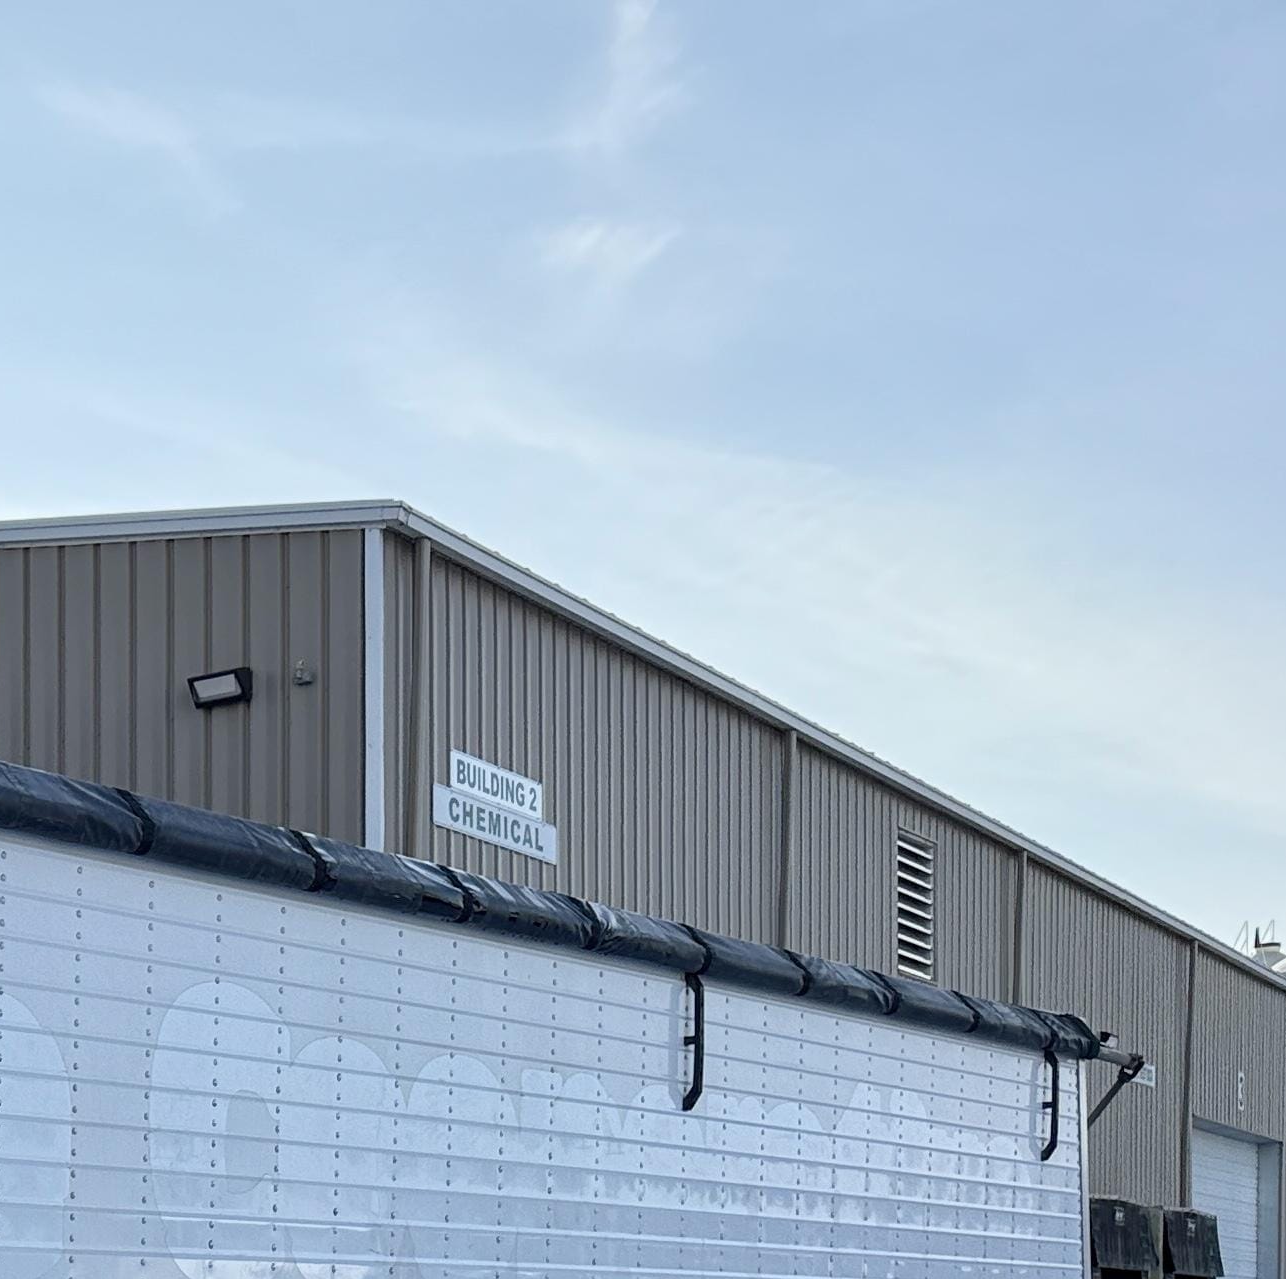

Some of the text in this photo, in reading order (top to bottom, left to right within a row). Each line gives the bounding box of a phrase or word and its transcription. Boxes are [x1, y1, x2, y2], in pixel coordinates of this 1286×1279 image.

[456, 758, 537, 812] BUILDING 2
[448, 797, 544, 852] CHEMICAL
